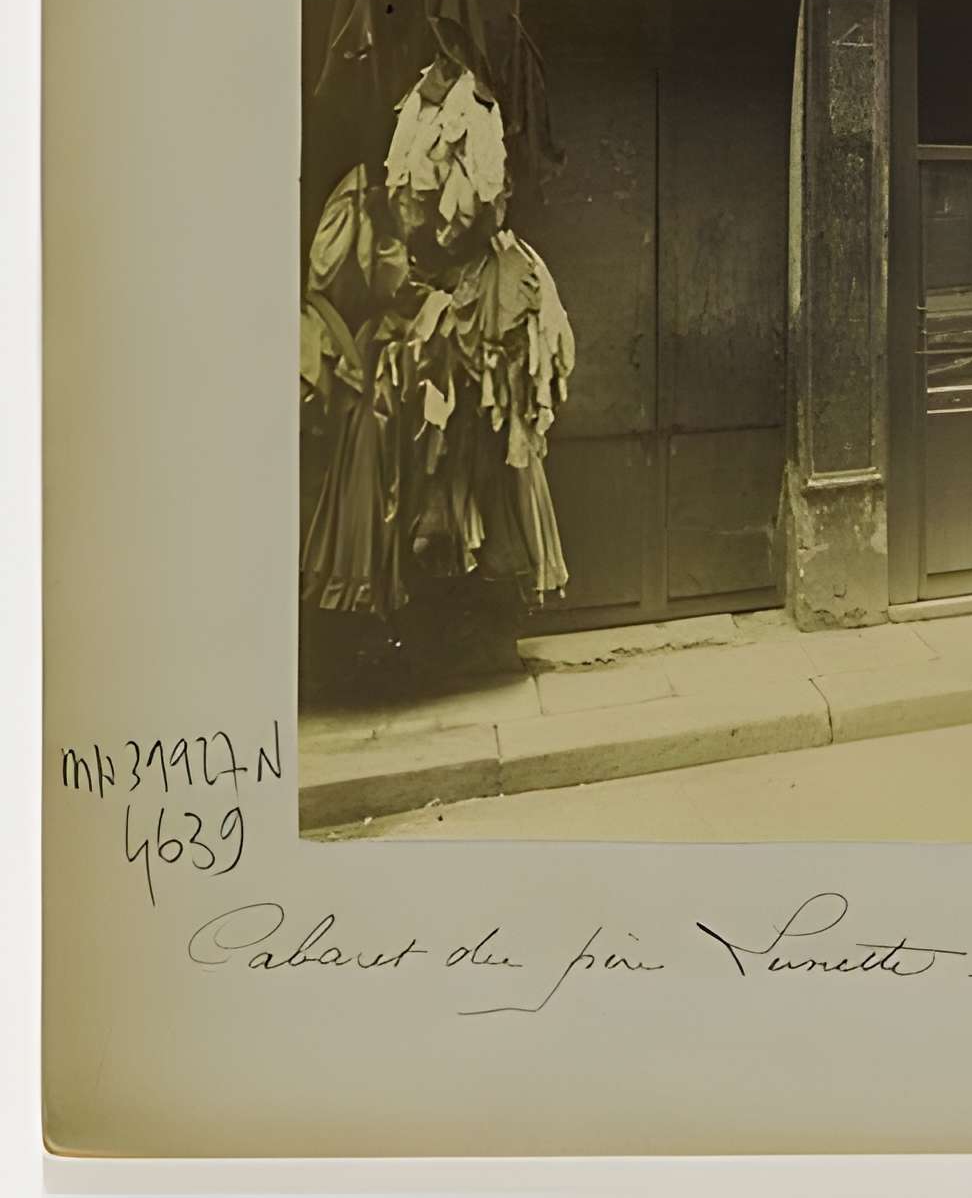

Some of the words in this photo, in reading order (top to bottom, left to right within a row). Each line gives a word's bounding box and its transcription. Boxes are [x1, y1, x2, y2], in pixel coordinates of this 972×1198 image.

[125, 804, 244, 906] 4639
[188, 903, 428, 970] Cabaret
[445, 927, 524, 968] du
[696, 893, 968, 977] Lunette
